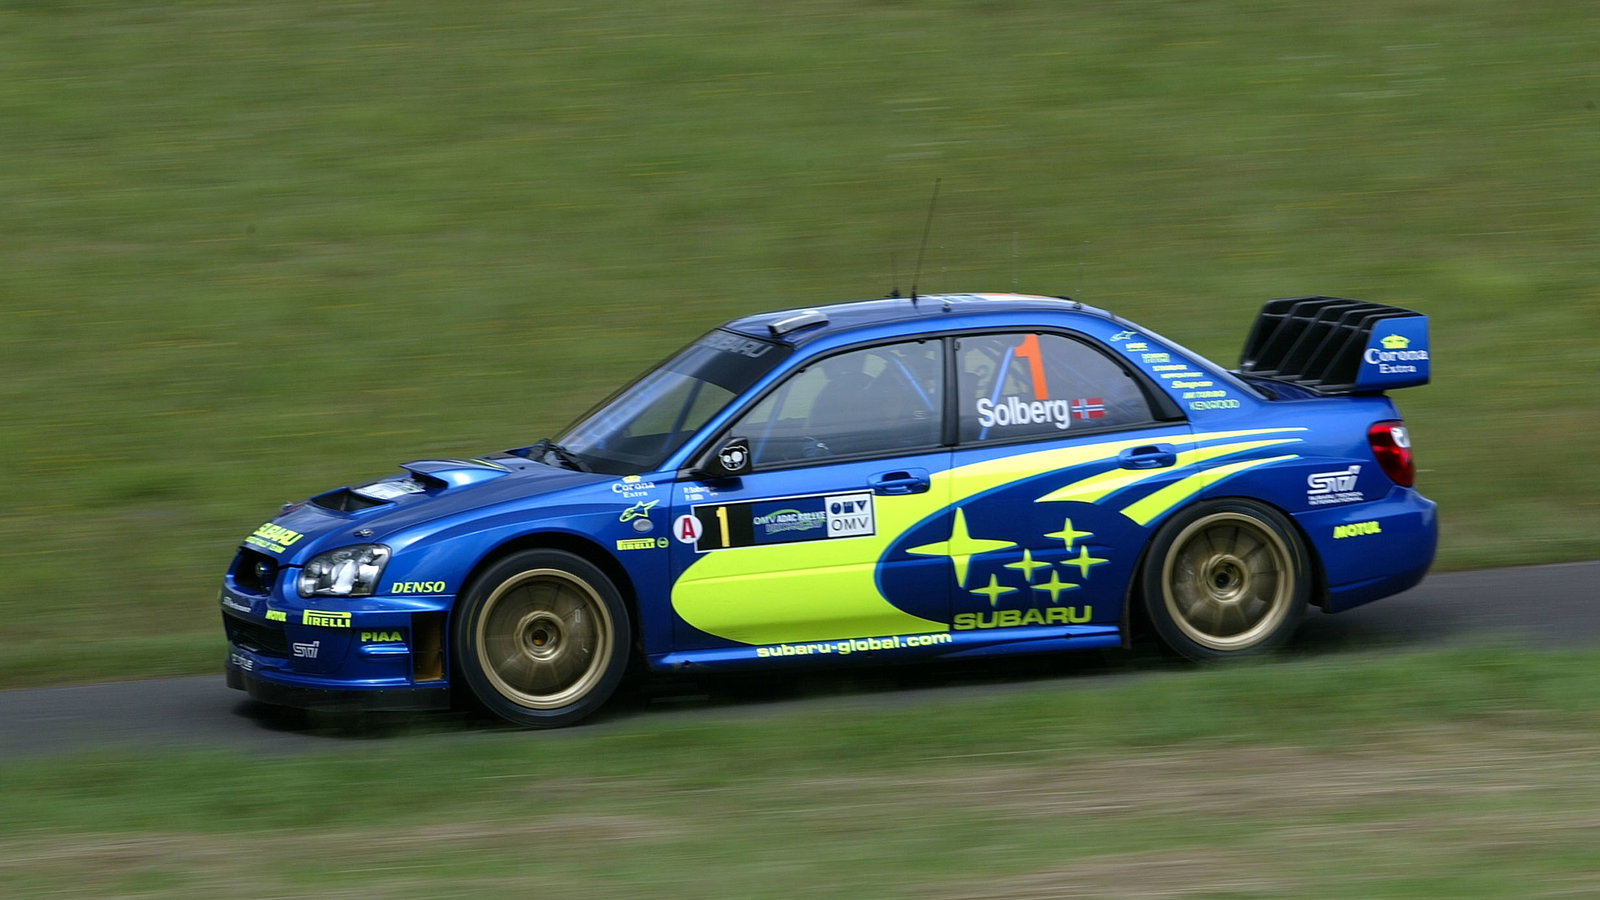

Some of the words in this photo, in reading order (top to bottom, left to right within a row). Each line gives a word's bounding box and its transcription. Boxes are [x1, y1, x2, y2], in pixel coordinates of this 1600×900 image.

[1364, 348, 1429, 365] Corona
[1014, 333, 1049, 400] 1
[1379, 363, 1417, 374] Extra
[976, 396, 1071, 429] Solberg
[612, 482, 656, 493] Corona
[681, 517, 696, 539] A
[716, 506, 730, 547] 1
[753, 515, 777, 525] OMV
[776, 513, 798, 523] ADAC
[831, 517, 869, 531] OMV
[1332, 521, 1382, 539] MOTUL
[391, 581, 446, 593] DENSO
[302, 609, 352, 628] PIRELLI
[953, 605, 1092, 630] SUBARU
[361, 631, 403, 642] PIAA
[756, 633, 952, 657] subaru-global.com
